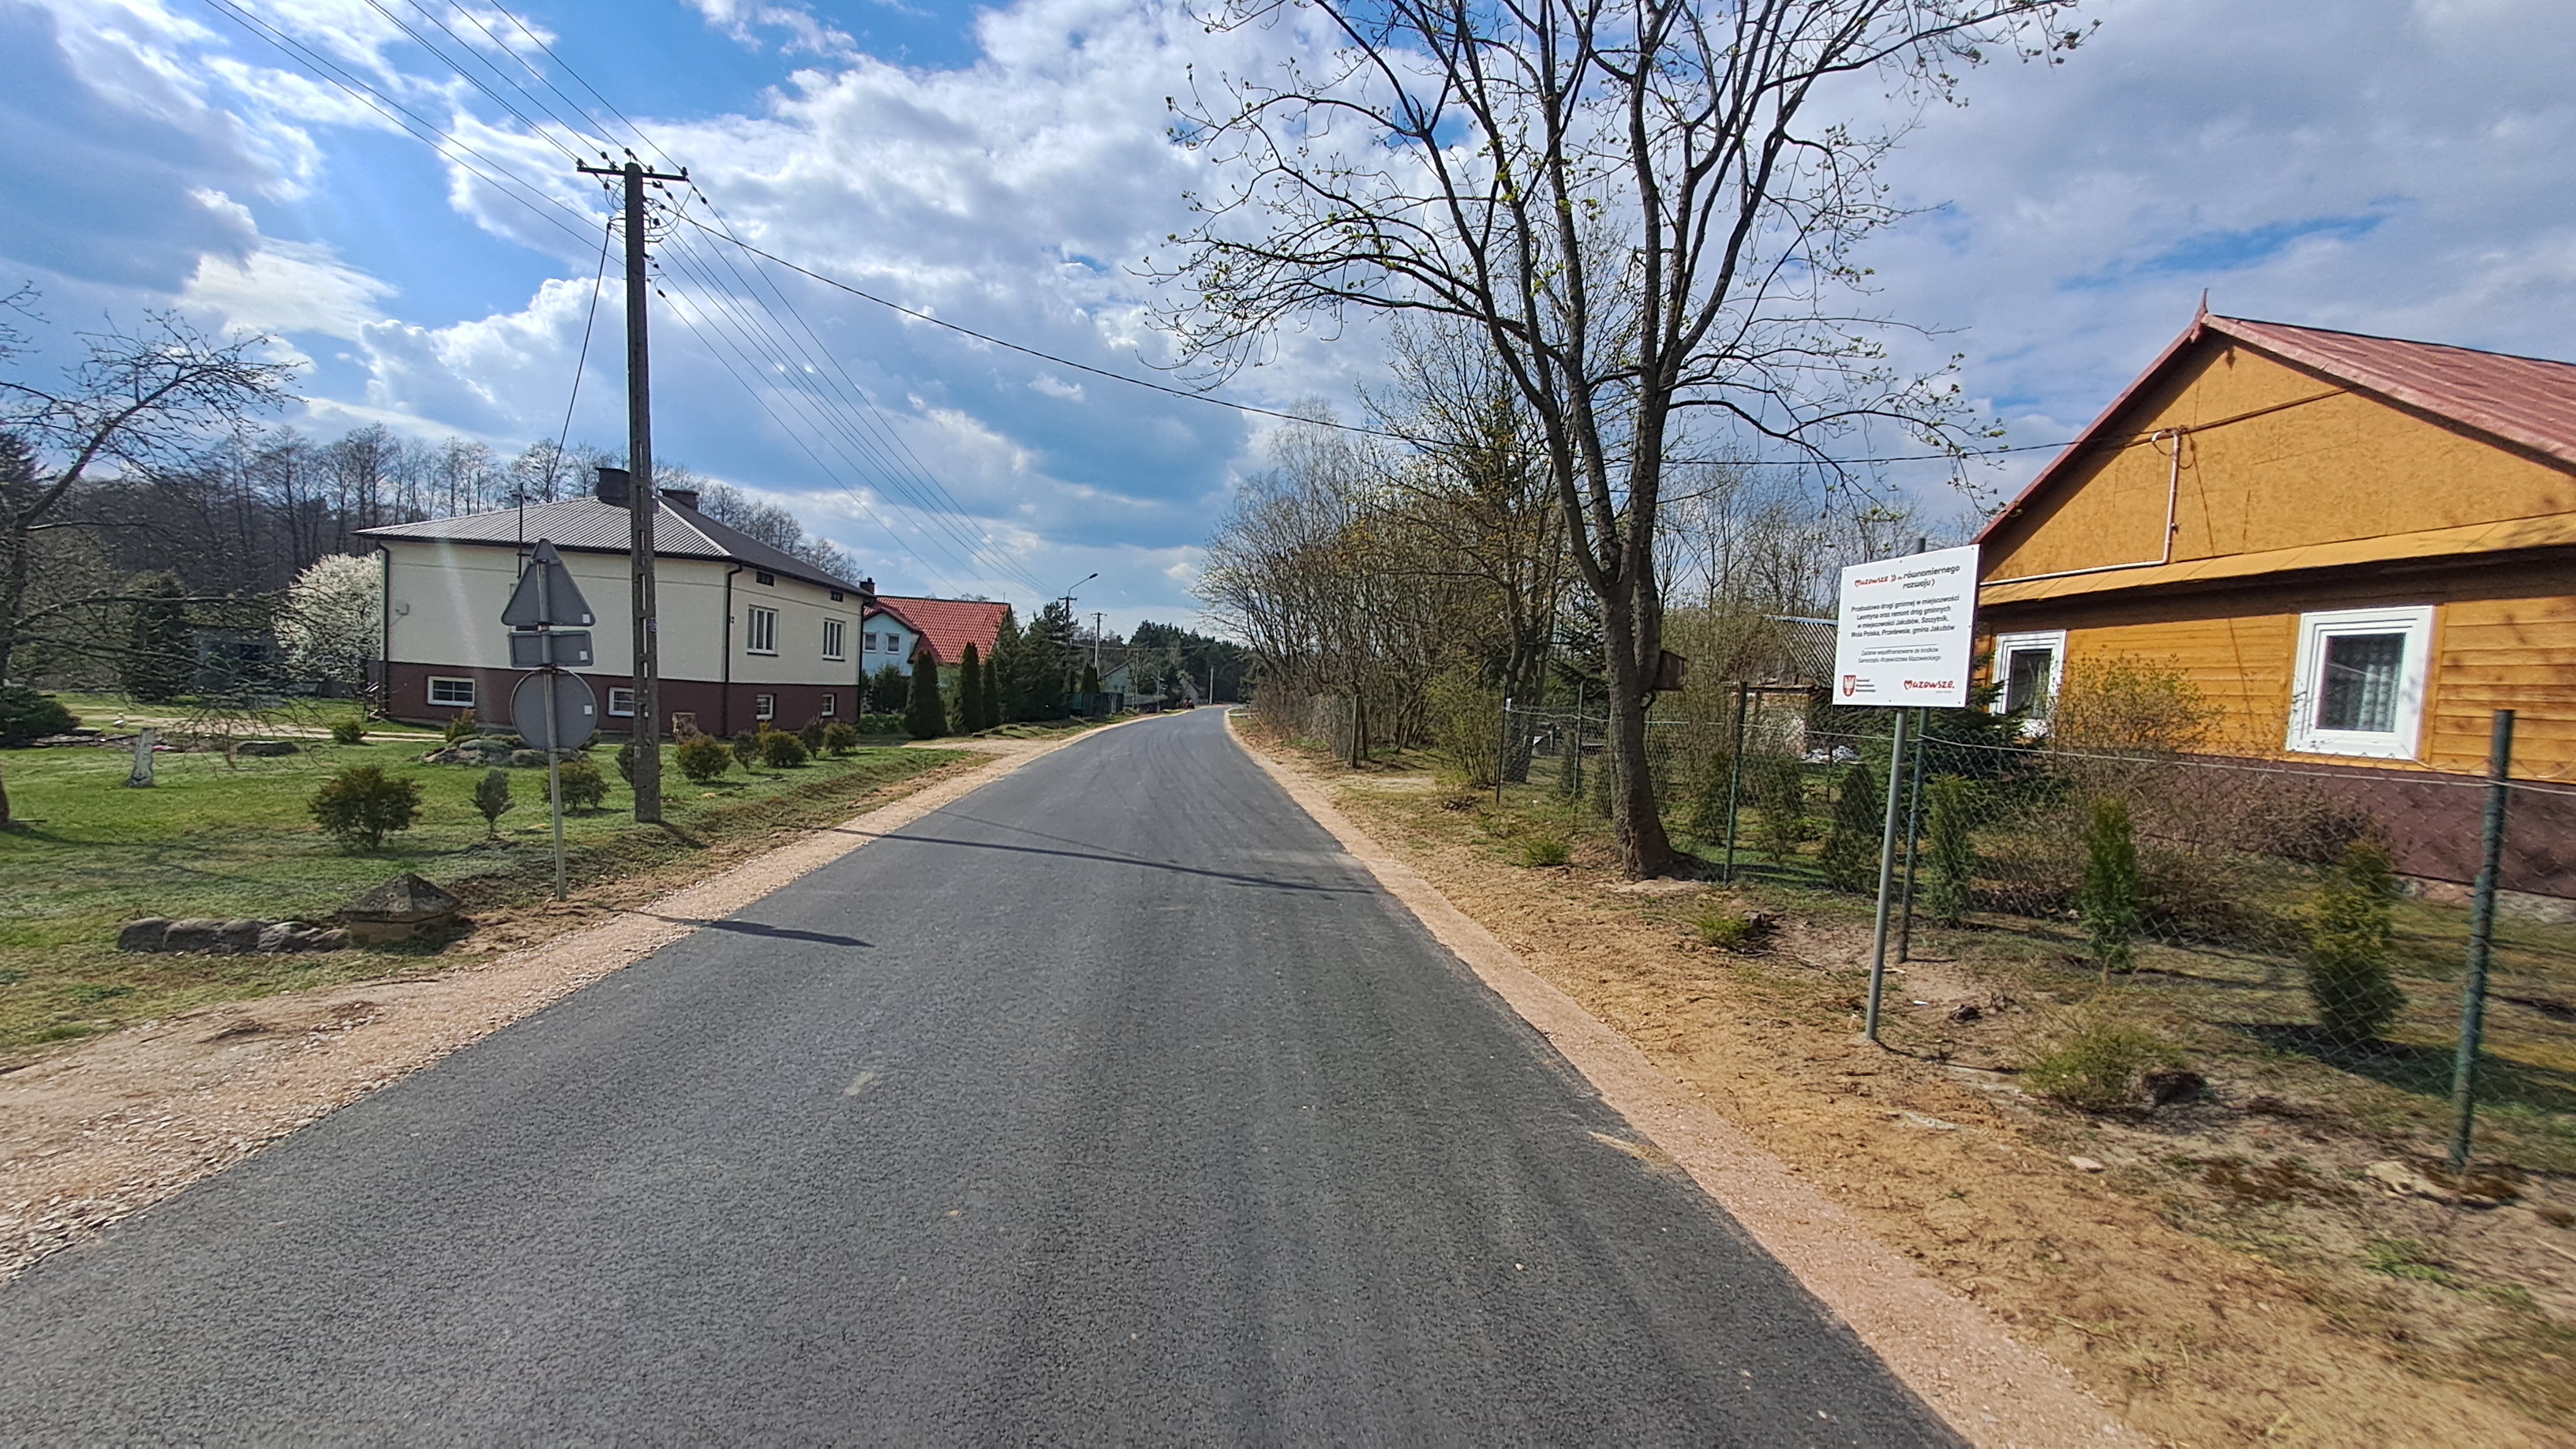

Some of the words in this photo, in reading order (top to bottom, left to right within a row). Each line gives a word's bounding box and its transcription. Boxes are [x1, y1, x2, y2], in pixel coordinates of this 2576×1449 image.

[1903, 565, 1960, 578] równomiernego
[1903, 578, 1930, 589] rozwoju
[1895, 600, 1915, 608] gminnej
[1922, 594, 1960, 605] miejscowości
[1924, 606, 1951, 615] gminnych
[1862, 620, 1895, 629] miejscowości
[1912, 626, 1929, 635] gmina
